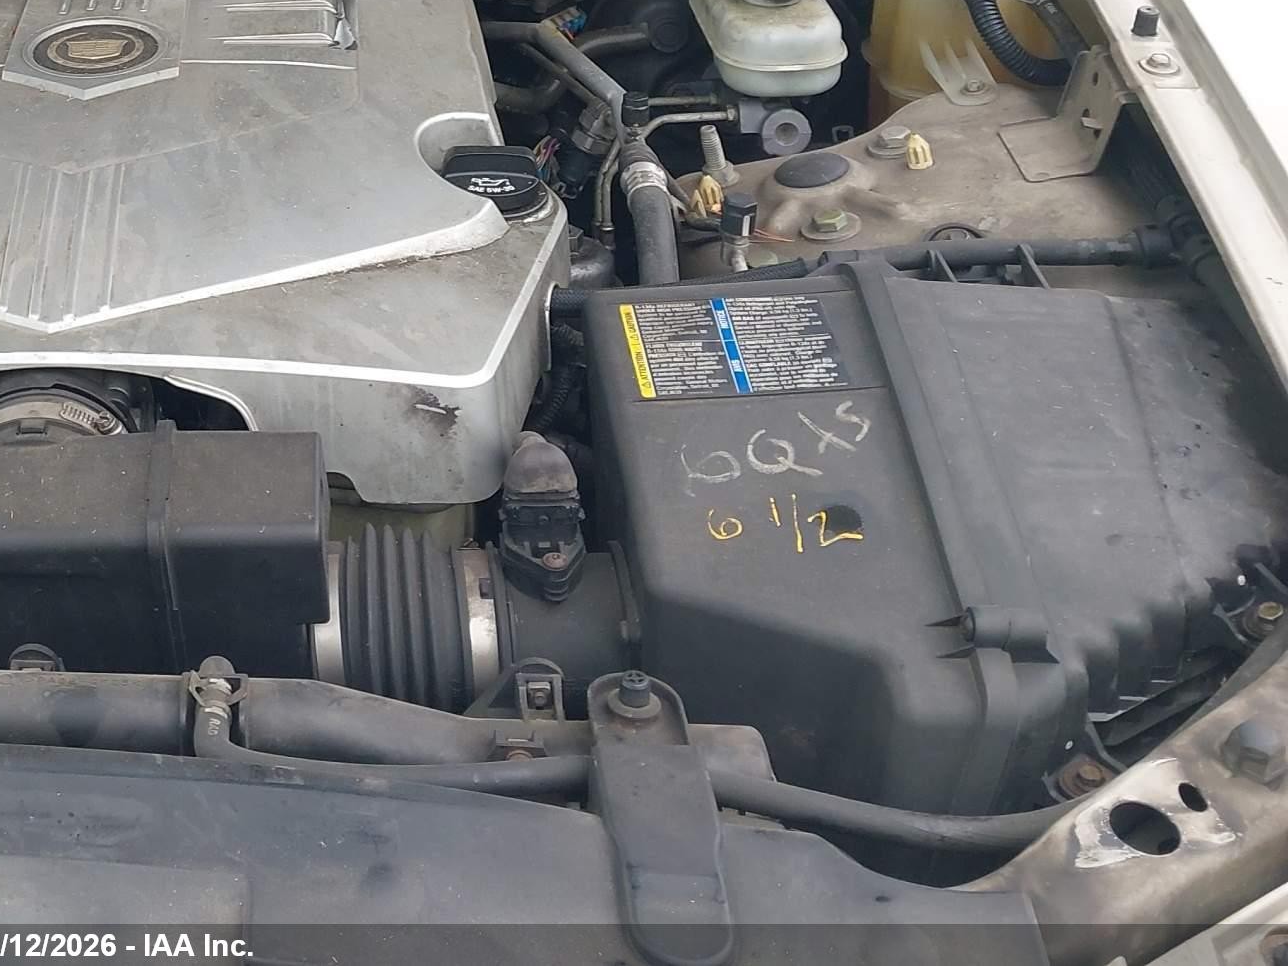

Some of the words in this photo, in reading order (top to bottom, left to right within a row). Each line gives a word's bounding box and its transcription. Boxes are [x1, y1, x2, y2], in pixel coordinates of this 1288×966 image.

[468, 185, 486, 193] SAE
[624, 312, 638, 333] CAUTION
[715, 310, 730, 330] NOTICE
[634, 351, 651, 380] ATTENTION
[730, 359, 744, 372] AVIS
[708, 509, 743, 540] 6
